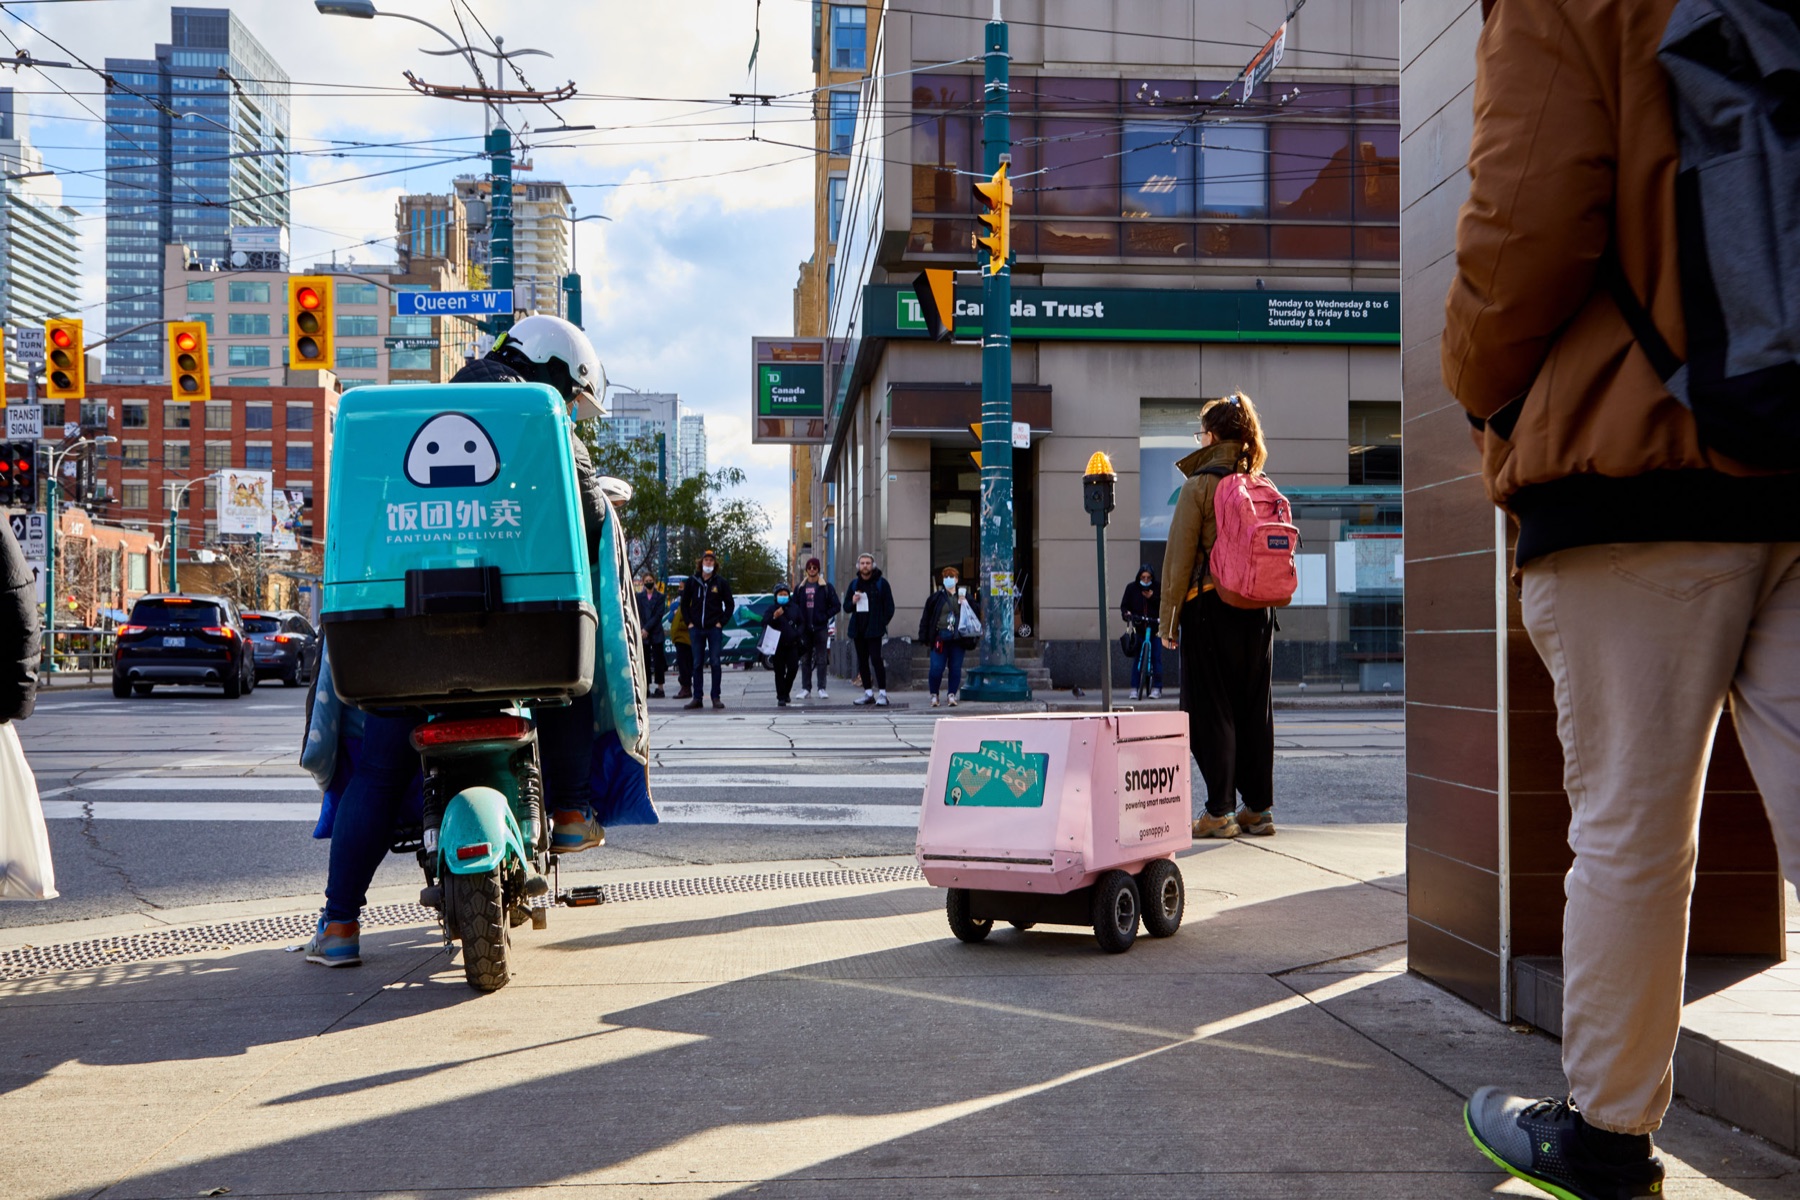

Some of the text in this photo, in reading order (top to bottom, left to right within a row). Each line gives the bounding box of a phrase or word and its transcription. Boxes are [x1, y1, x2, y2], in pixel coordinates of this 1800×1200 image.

[414, 293, 496, 311] Queen St W
[1268, 299, 1302, 309] Monday
[1316, 300, 1363, 310] Wednesday
[955, 300, 1037, 316] Cada
[1042, 301, 1104, 318] Trust
[1268, 308, 1306, 318] Thursday
[1308, 309, 1315, 317] &
[1317, 309, 1342, 319] Friday
[1352, 310, 1360, 318] to
[1362, 310, 1368, 318] 8
[1268, 318, 1305, 328] Saturday
[20, 341, 42, 349] TURN
[768, 373, 780, 383] TD
[771, 386, 805, 394] Canada
[772, 395, 797, 403] Trust
[9, 409, 40, 420] TRANSIT
[11, 423, 38, 435] SIGNAL
[386, 499, 522, 531] 饭团外卖
[71, 522, 84, 536] 147
[386, 531, 522, 544] FANTUAN DELIVERY
[1125, 795, 1181, 812] powering smart restaurants
[1139, 822, 1170, 841] gosnappy.io
